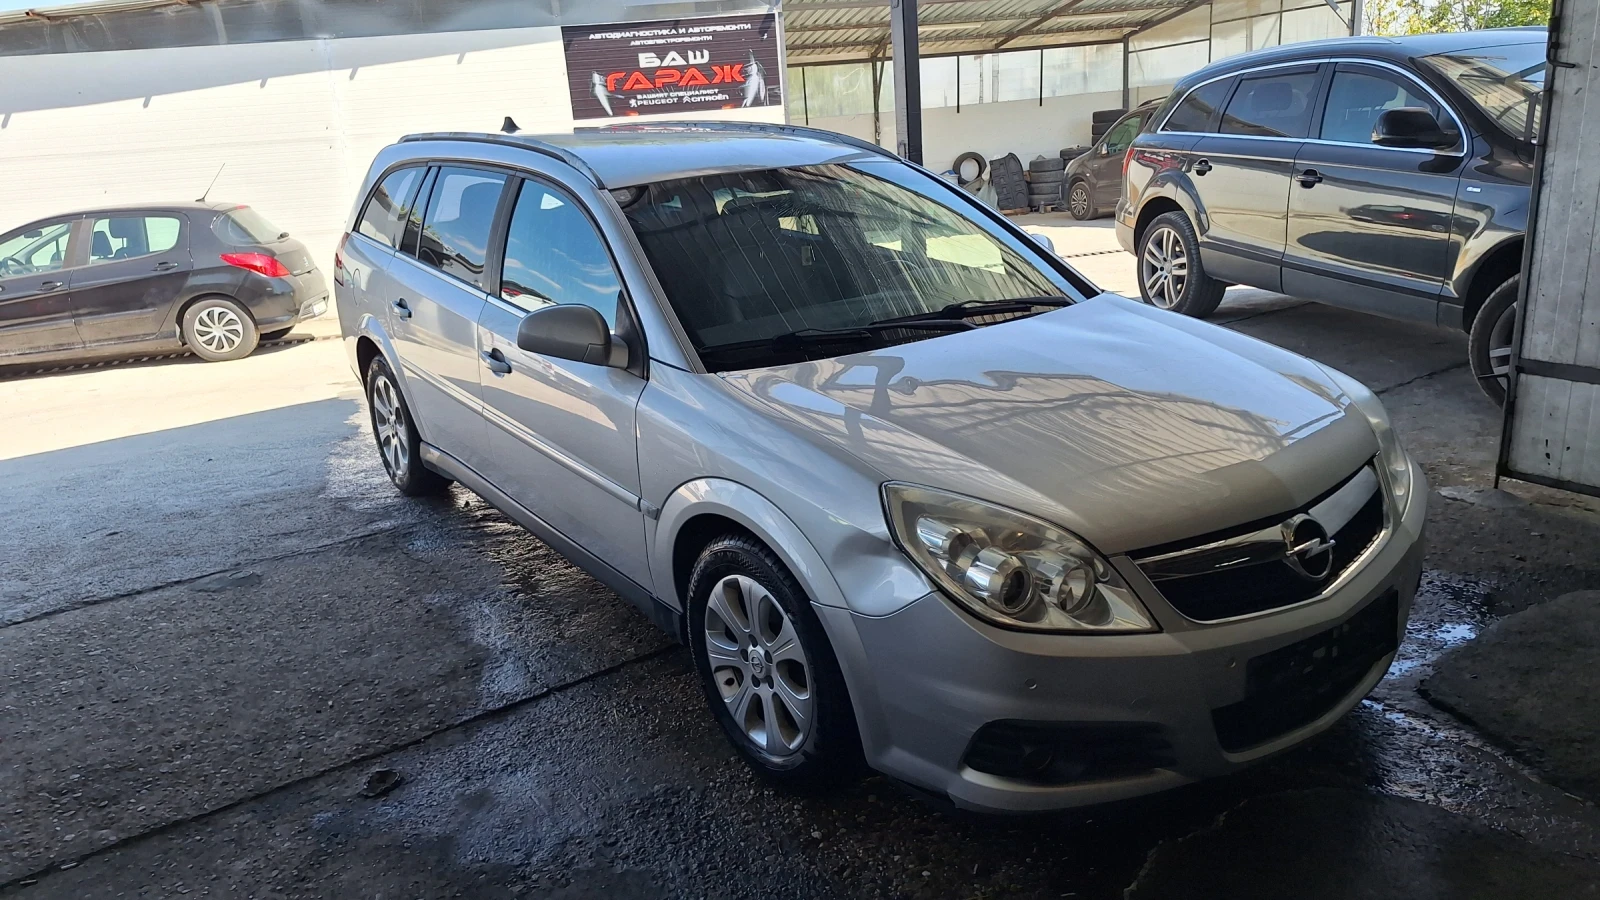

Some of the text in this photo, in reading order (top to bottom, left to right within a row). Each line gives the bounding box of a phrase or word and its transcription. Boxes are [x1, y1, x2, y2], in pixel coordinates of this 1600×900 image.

[589, 30, 677, 39] АВТОДИАГНОСТИКА
[688, 23, 751, 34] АВТОРЕМОНТИ
[630, 35, 713, 46] АВТОЕЛЕКТРОРЕМОНТИ
[638, 49, 710, 69] БАШ
[606, 64, 746, 91] ГАРАЖ
[636, 88, 719, 100] ВАШИЯТ СПЕЦИАЛИСТ
[637, 98, 679, 106] PEUGEOT
